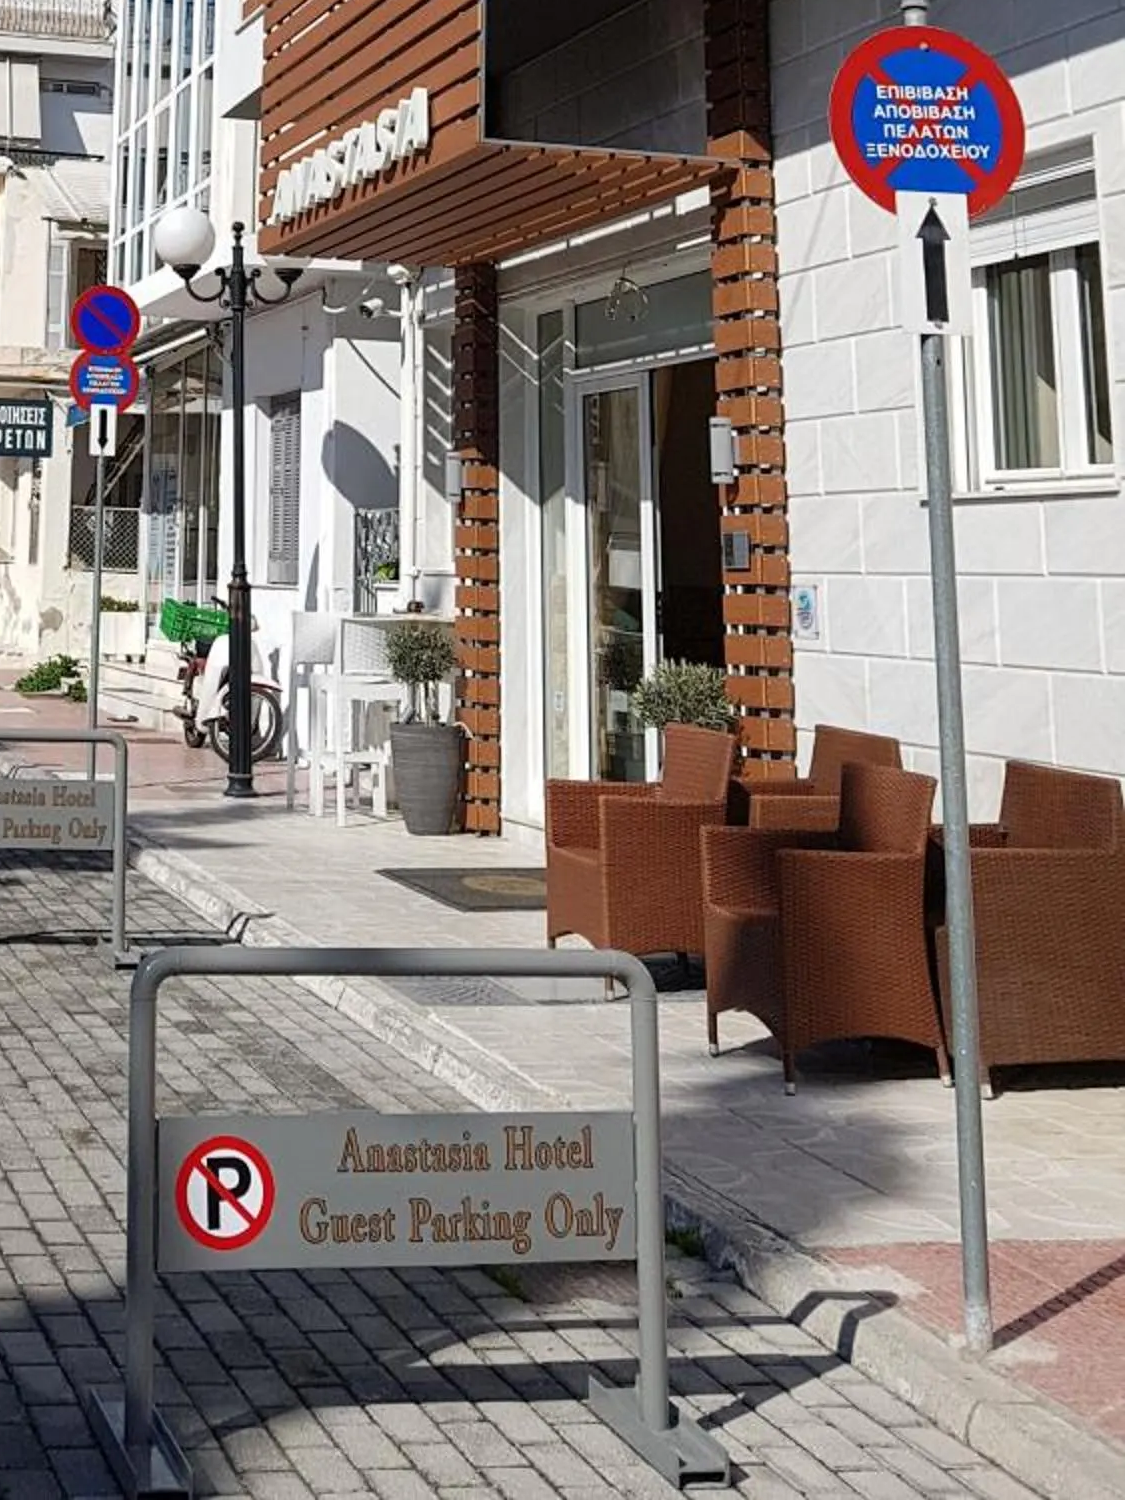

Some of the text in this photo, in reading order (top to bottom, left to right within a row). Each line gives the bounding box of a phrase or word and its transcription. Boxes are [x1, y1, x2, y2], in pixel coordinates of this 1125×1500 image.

[876, 85, 969, 100] ΕΠΙΒΙΒΑΣΗ
[873, 104, 976, 120] ΑΠΟΒΙΒΑΣΗ
[883, 124, 969, 139] ΠΕΛΑΤΩΝ
[866, 143, 991, 160] ΞΕΝΟΔΟΧΕΙΟΥ
[52, 786, 96, 807] Hotel
[337, 1124, 594, 1173] Anastasia Hotel
[299, 1191, 624, 1255] Guest Parking Only
